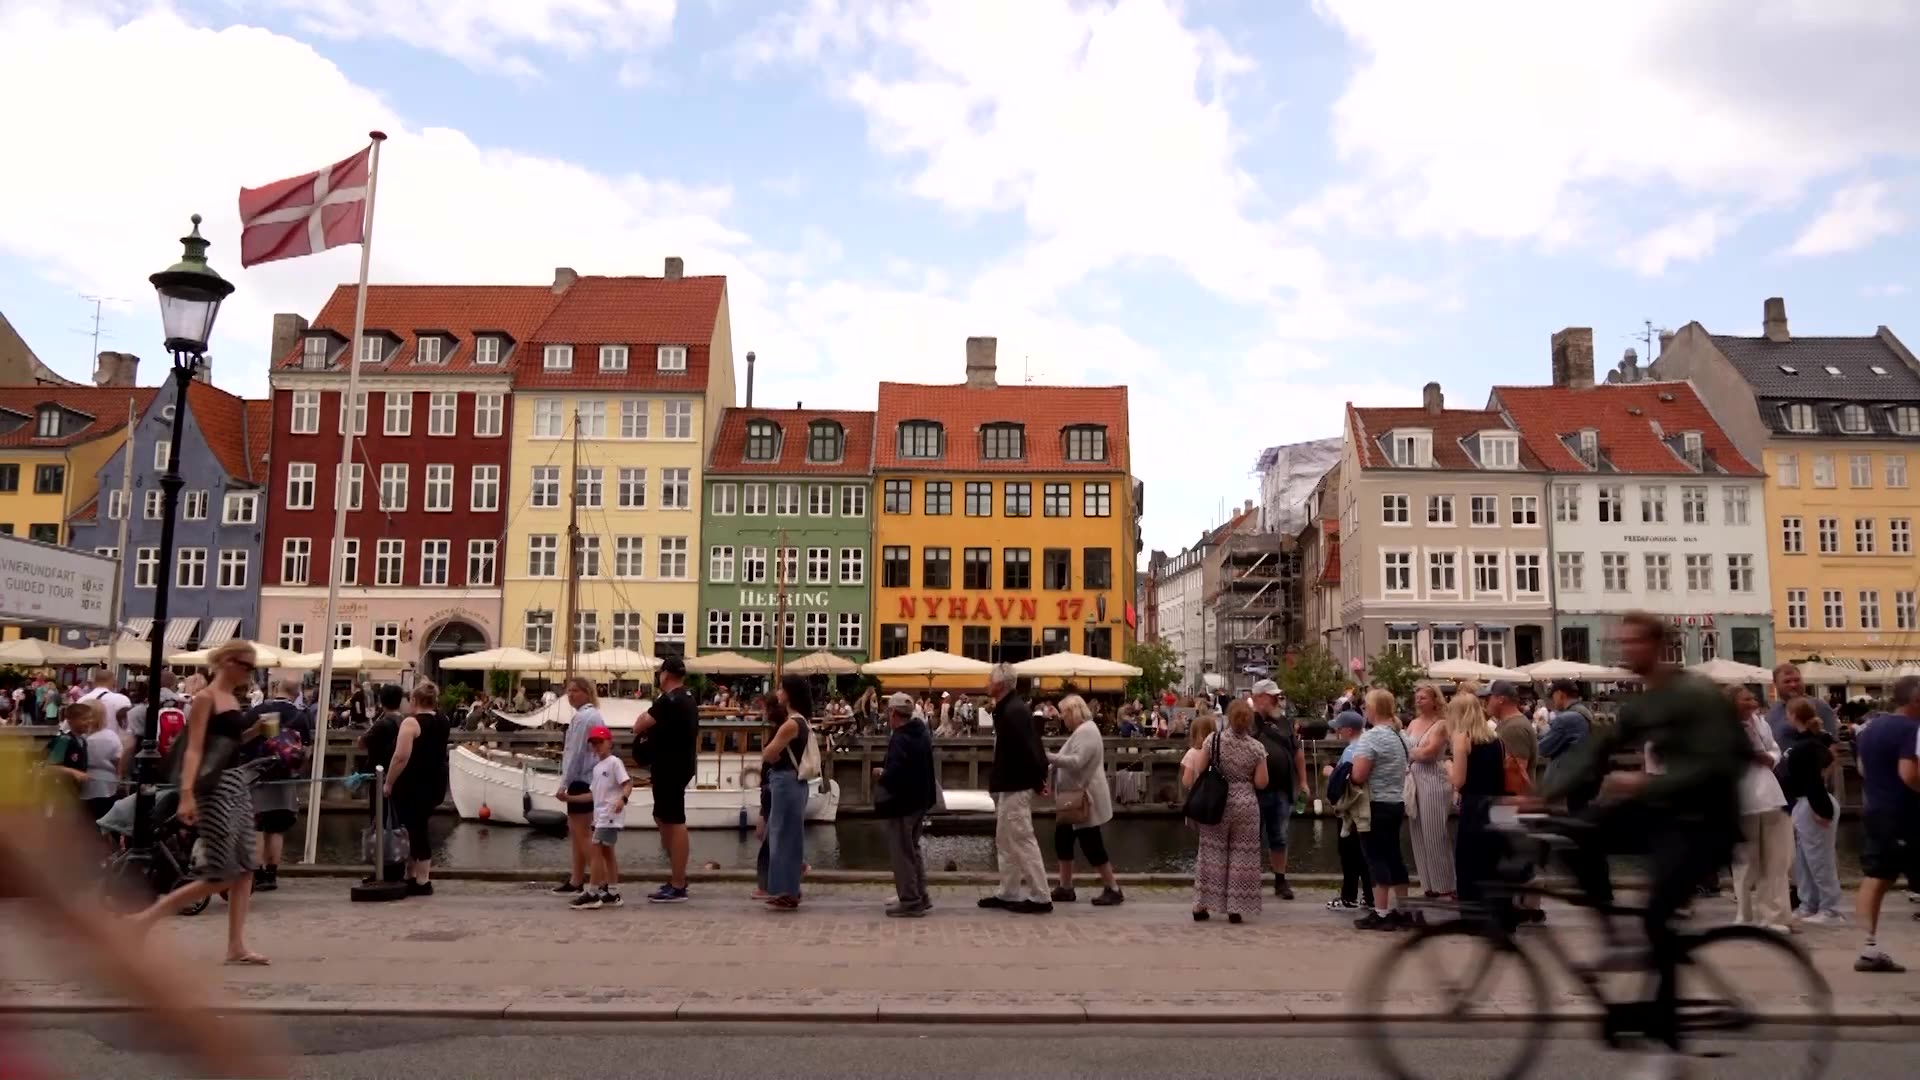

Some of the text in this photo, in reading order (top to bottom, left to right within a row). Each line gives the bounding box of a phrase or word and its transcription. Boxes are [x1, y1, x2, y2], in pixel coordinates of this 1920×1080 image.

[0, 559, 76, 582] VNERUNDFART
[6, 578, 74, 598] GUIDED TOUR
[740, 590, 829, 606] HEERING
[898, 597, 1084, 620] NYHAVN 17
